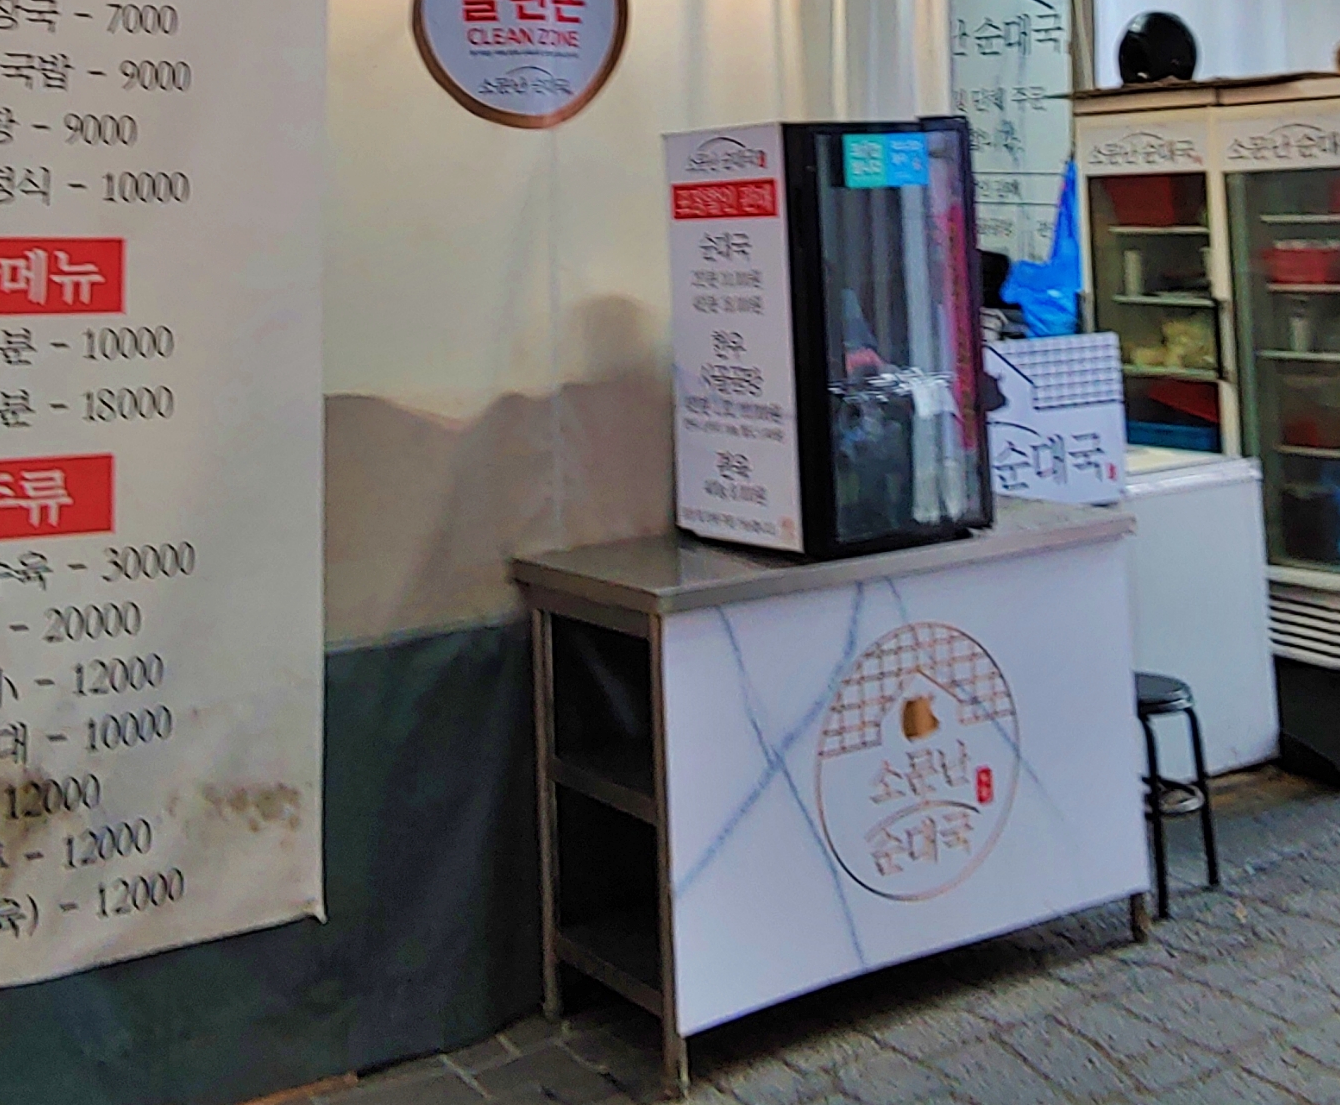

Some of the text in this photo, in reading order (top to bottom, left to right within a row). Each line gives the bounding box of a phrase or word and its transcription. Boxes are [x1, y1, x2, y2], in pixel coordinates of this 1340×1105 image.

[106, 1, 178, 36] 7000
[467, 28, 580, 48] CLEAN ZONE
[974, 13, 1065, 56] 순대국
[120, 59, 192, 93] 9000
[63, 113, 137, 147] 9000
[101, 171, 191, 204] 10000
[82, 325, 174, 361] 10000
[82, 385, 174, 422] 18000
[993, 432, 1106, 492] 순대국
[101, 540, 195, 582] 30000
[43, 602, 141, 643] 20000
[73, 652, 164, 696] 12000
[85, 705, 172, 752] 10000
[5, 773, 101, 821] 12000
[63, 818, 152, 869] 12000
[96, 868, 184, 918] 12000
